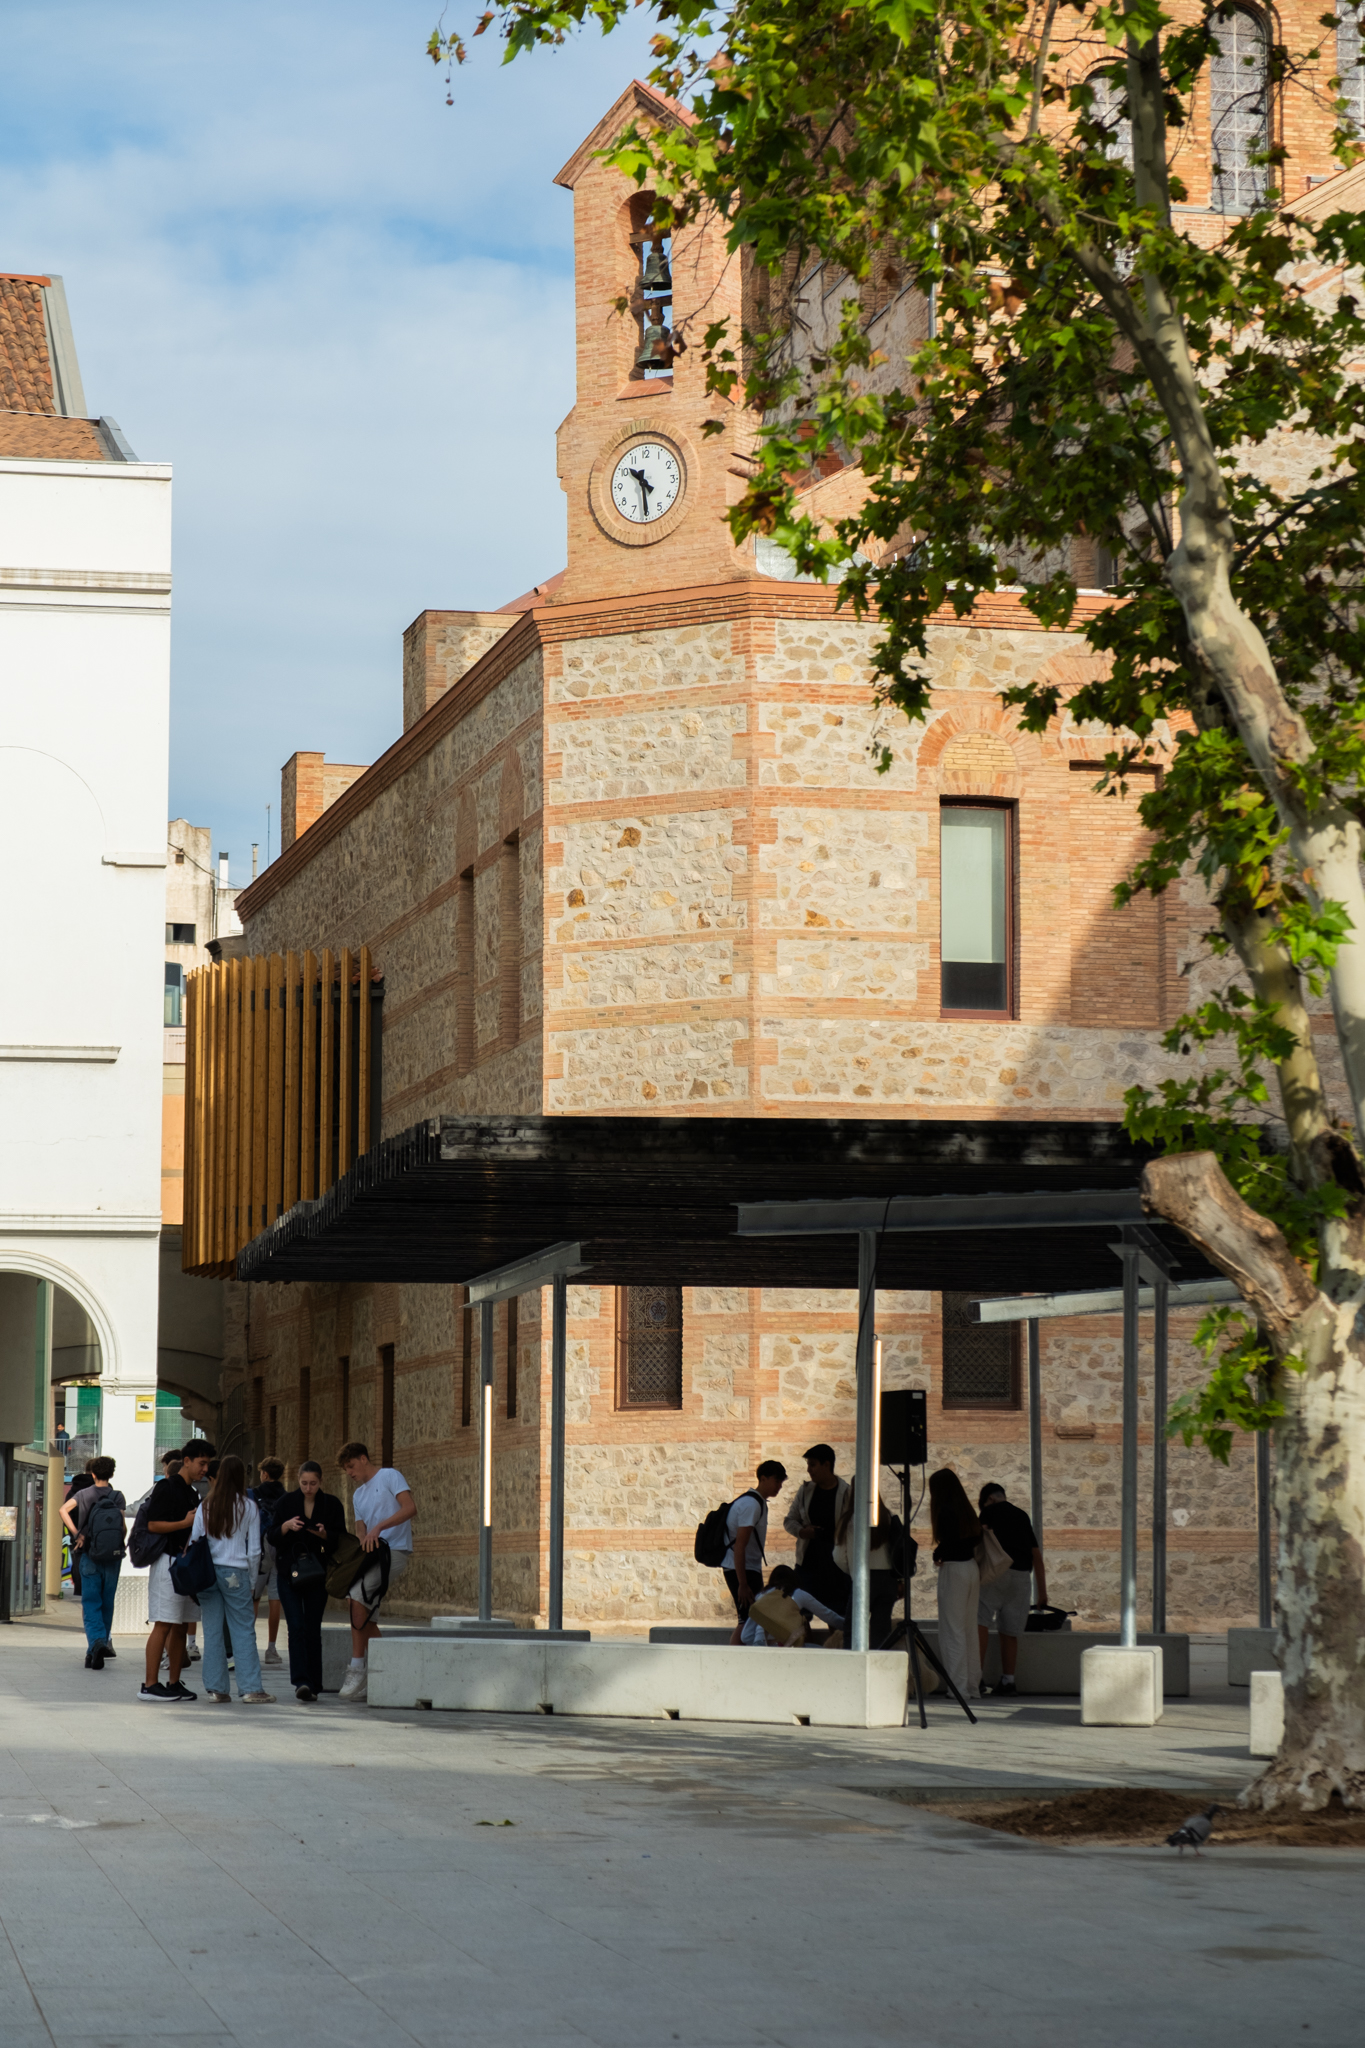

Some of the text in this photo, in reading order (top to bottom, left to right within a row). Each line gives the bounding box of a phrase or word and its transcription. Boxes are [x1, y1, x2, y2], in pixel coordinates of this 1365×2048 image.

[642, 449, 650, 459] 12
[631, 456, 636, 465] 11
[666, 460, 672, 470] 2
[621, 468, 629, 476] 10
[670, 474, 676, 484] 3
[618, 482, 624, 492] 9
[666, 490, 671, 498] 4
[622, 496, 627, 506] 8
[632, 504, 637, 514] 7
[656, 502, 662, 512] 5
